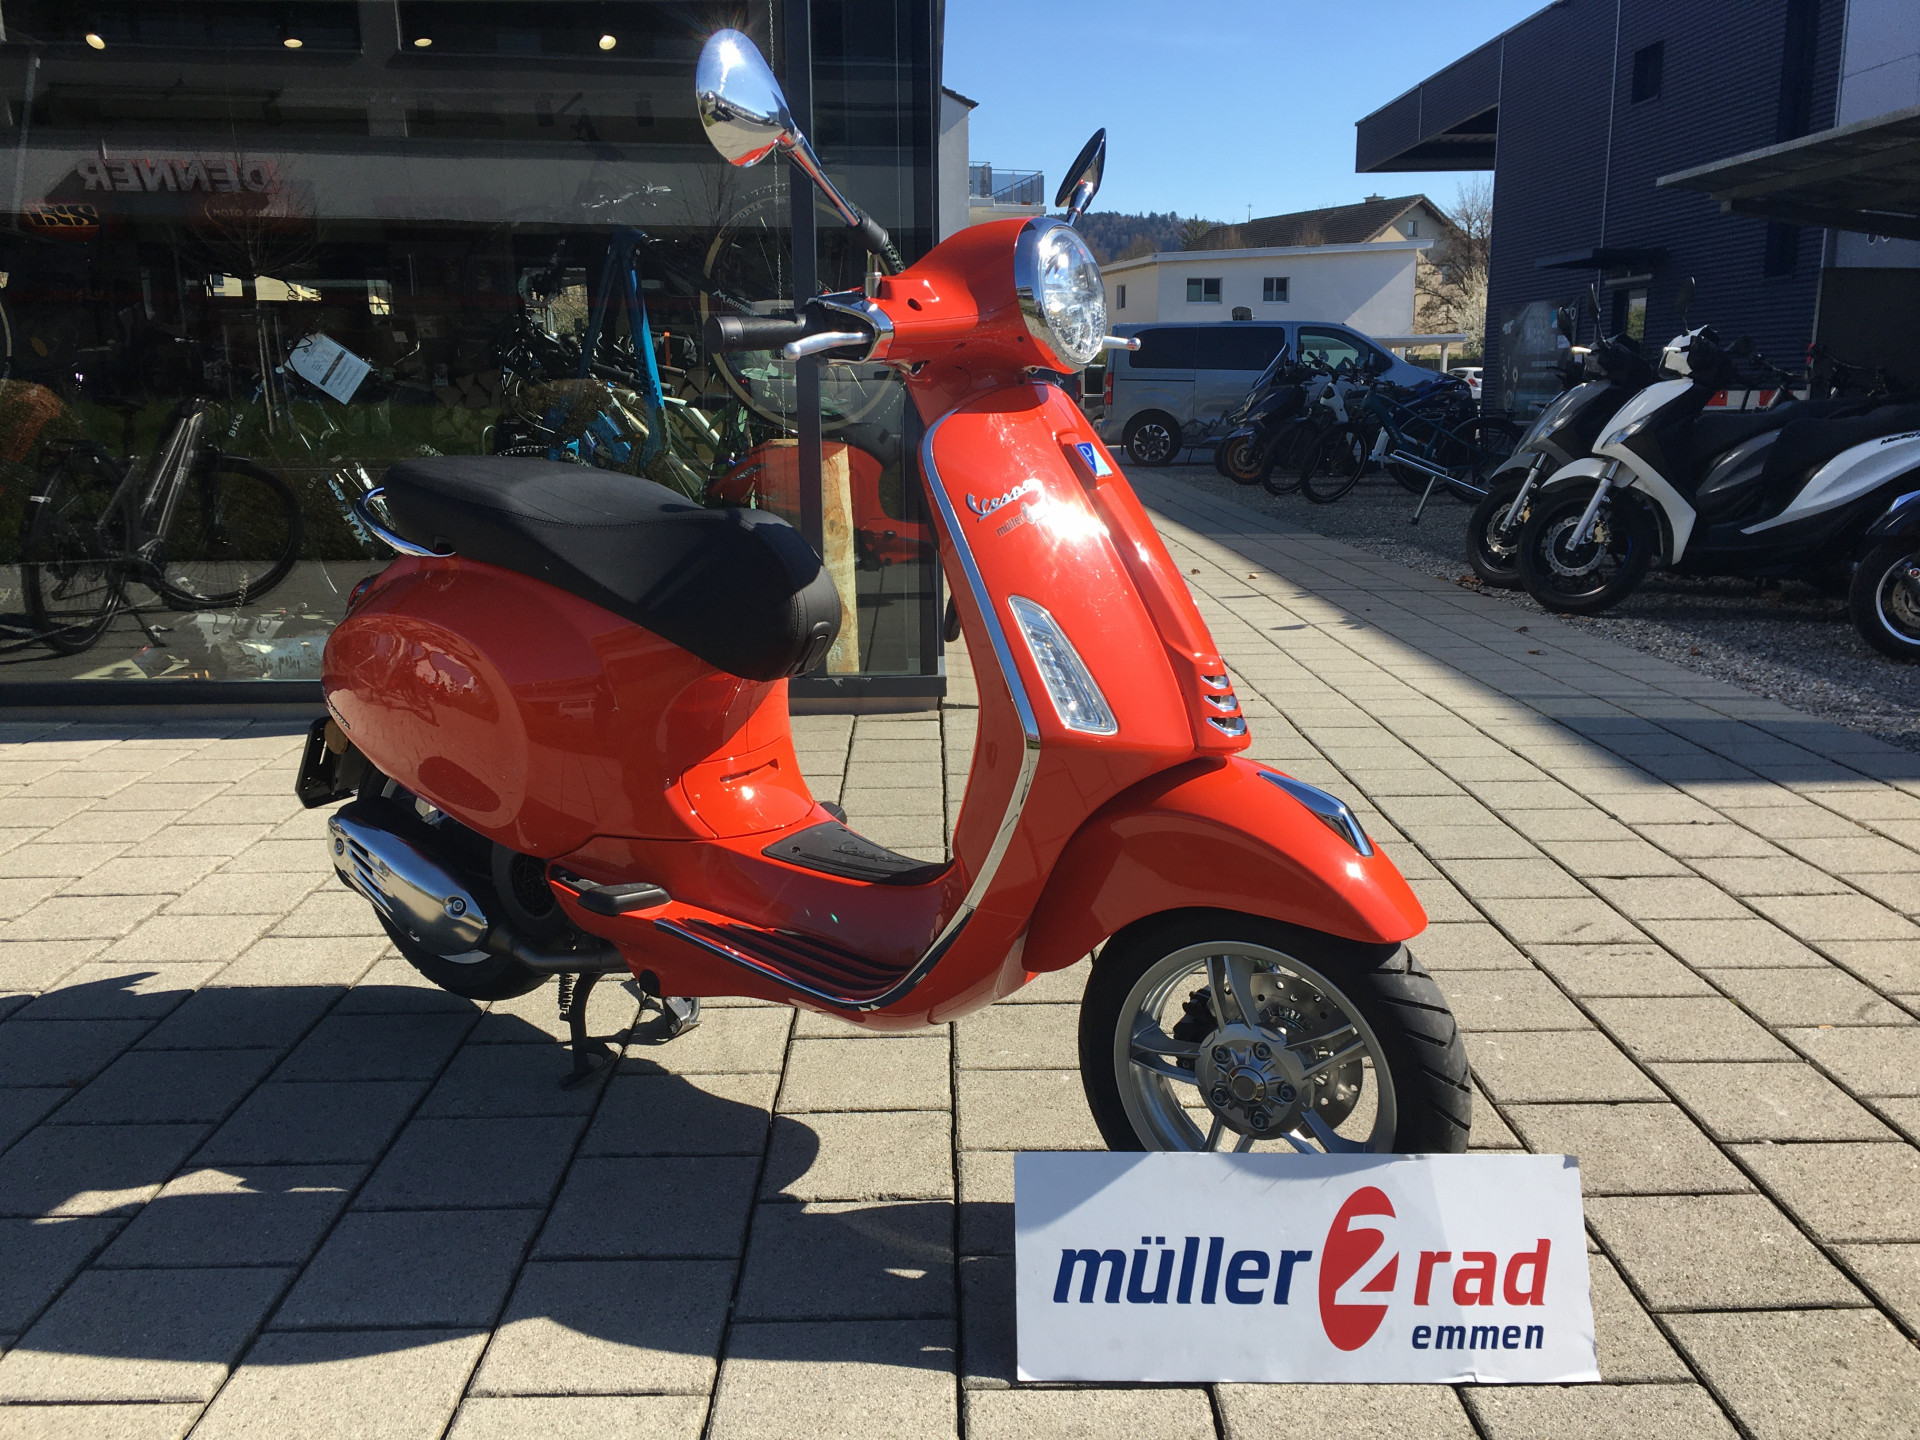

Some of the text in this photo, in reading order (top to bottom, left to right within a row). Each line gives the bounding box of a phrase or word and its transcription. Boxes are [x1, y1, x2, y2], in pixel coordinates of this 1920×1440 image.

[213, 208, 243, 217] MOTO
[228, 412, 244, 438] BIXS
[1053, 1237, 1313, 1305] müller
[1414, 1239, 1551, 1306] rad
[1412, 1325, 1544, 1350] emmen
